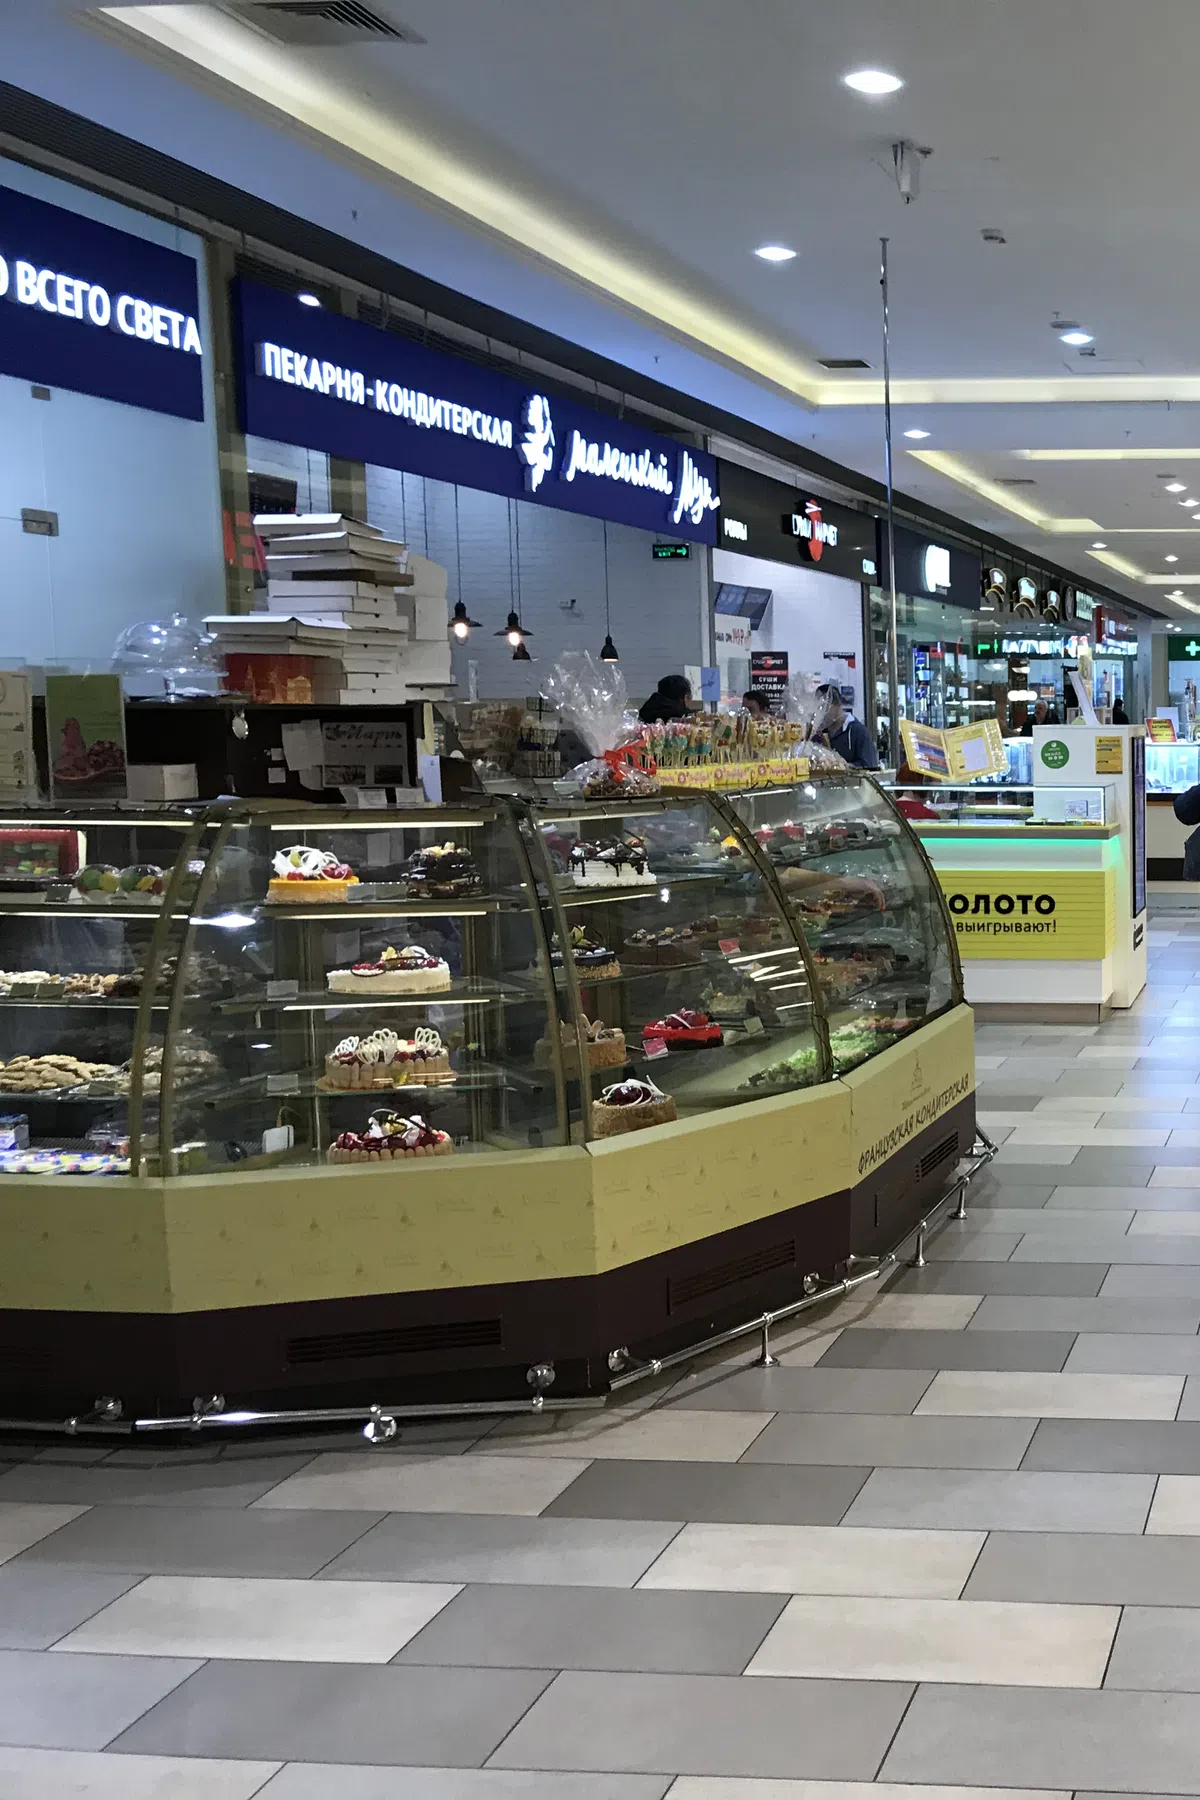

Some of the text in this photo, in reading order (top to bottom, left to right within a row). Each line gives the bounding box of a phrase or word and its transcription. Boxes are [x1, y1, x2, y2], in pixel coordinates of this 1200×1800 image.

[16, 260, 111, 327] ВСЕГО
[116, 294, 203, 355] СВЕТА
[944, 893, 1056, 915] ОЛОТО
[955, 919, 1057, 936] выигрывают!
[915, 1072, 969, 1129] КОНДИТЕРСКАЯ
